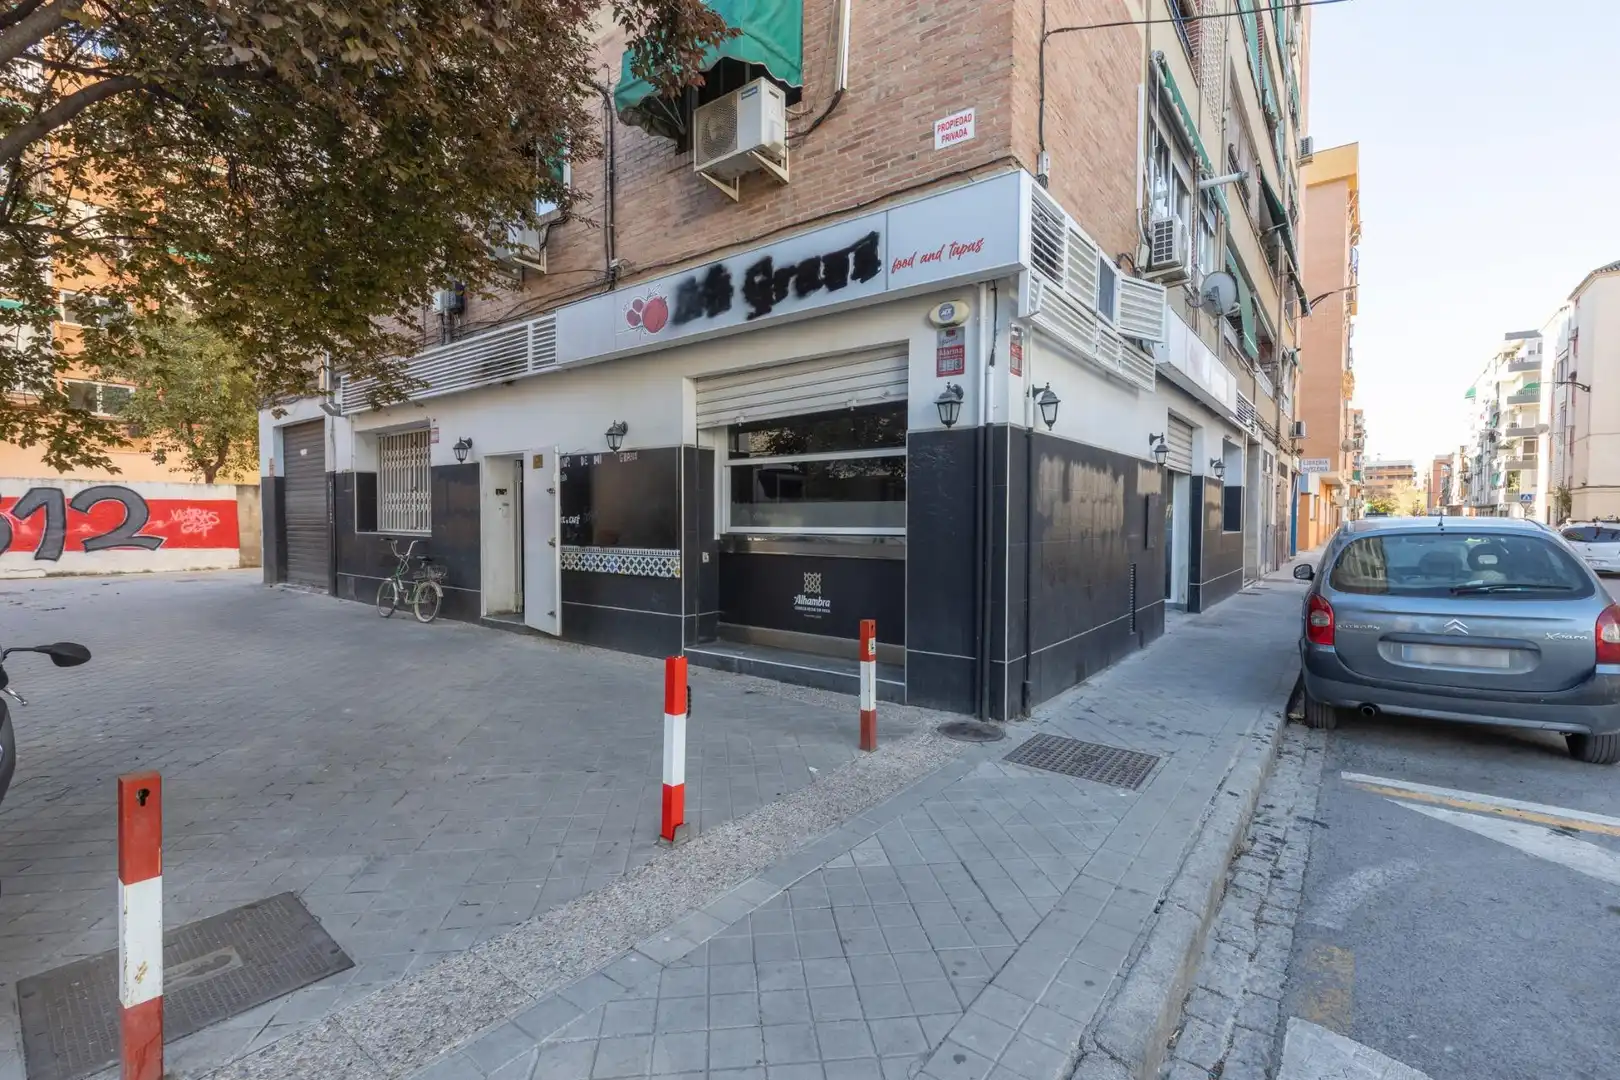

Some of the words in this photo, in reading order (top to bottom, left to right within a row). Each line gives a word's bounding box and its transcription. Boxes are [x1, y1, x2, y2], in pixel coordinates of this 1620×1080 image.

[937, 113, 972, 133] PROPIEDAD
[941, 127, 968, 144] PRIVADA
[891, 251, 917, 274] food
[920, 243, 945, 263] and
[793, 594, 831, 607] Alhambra
